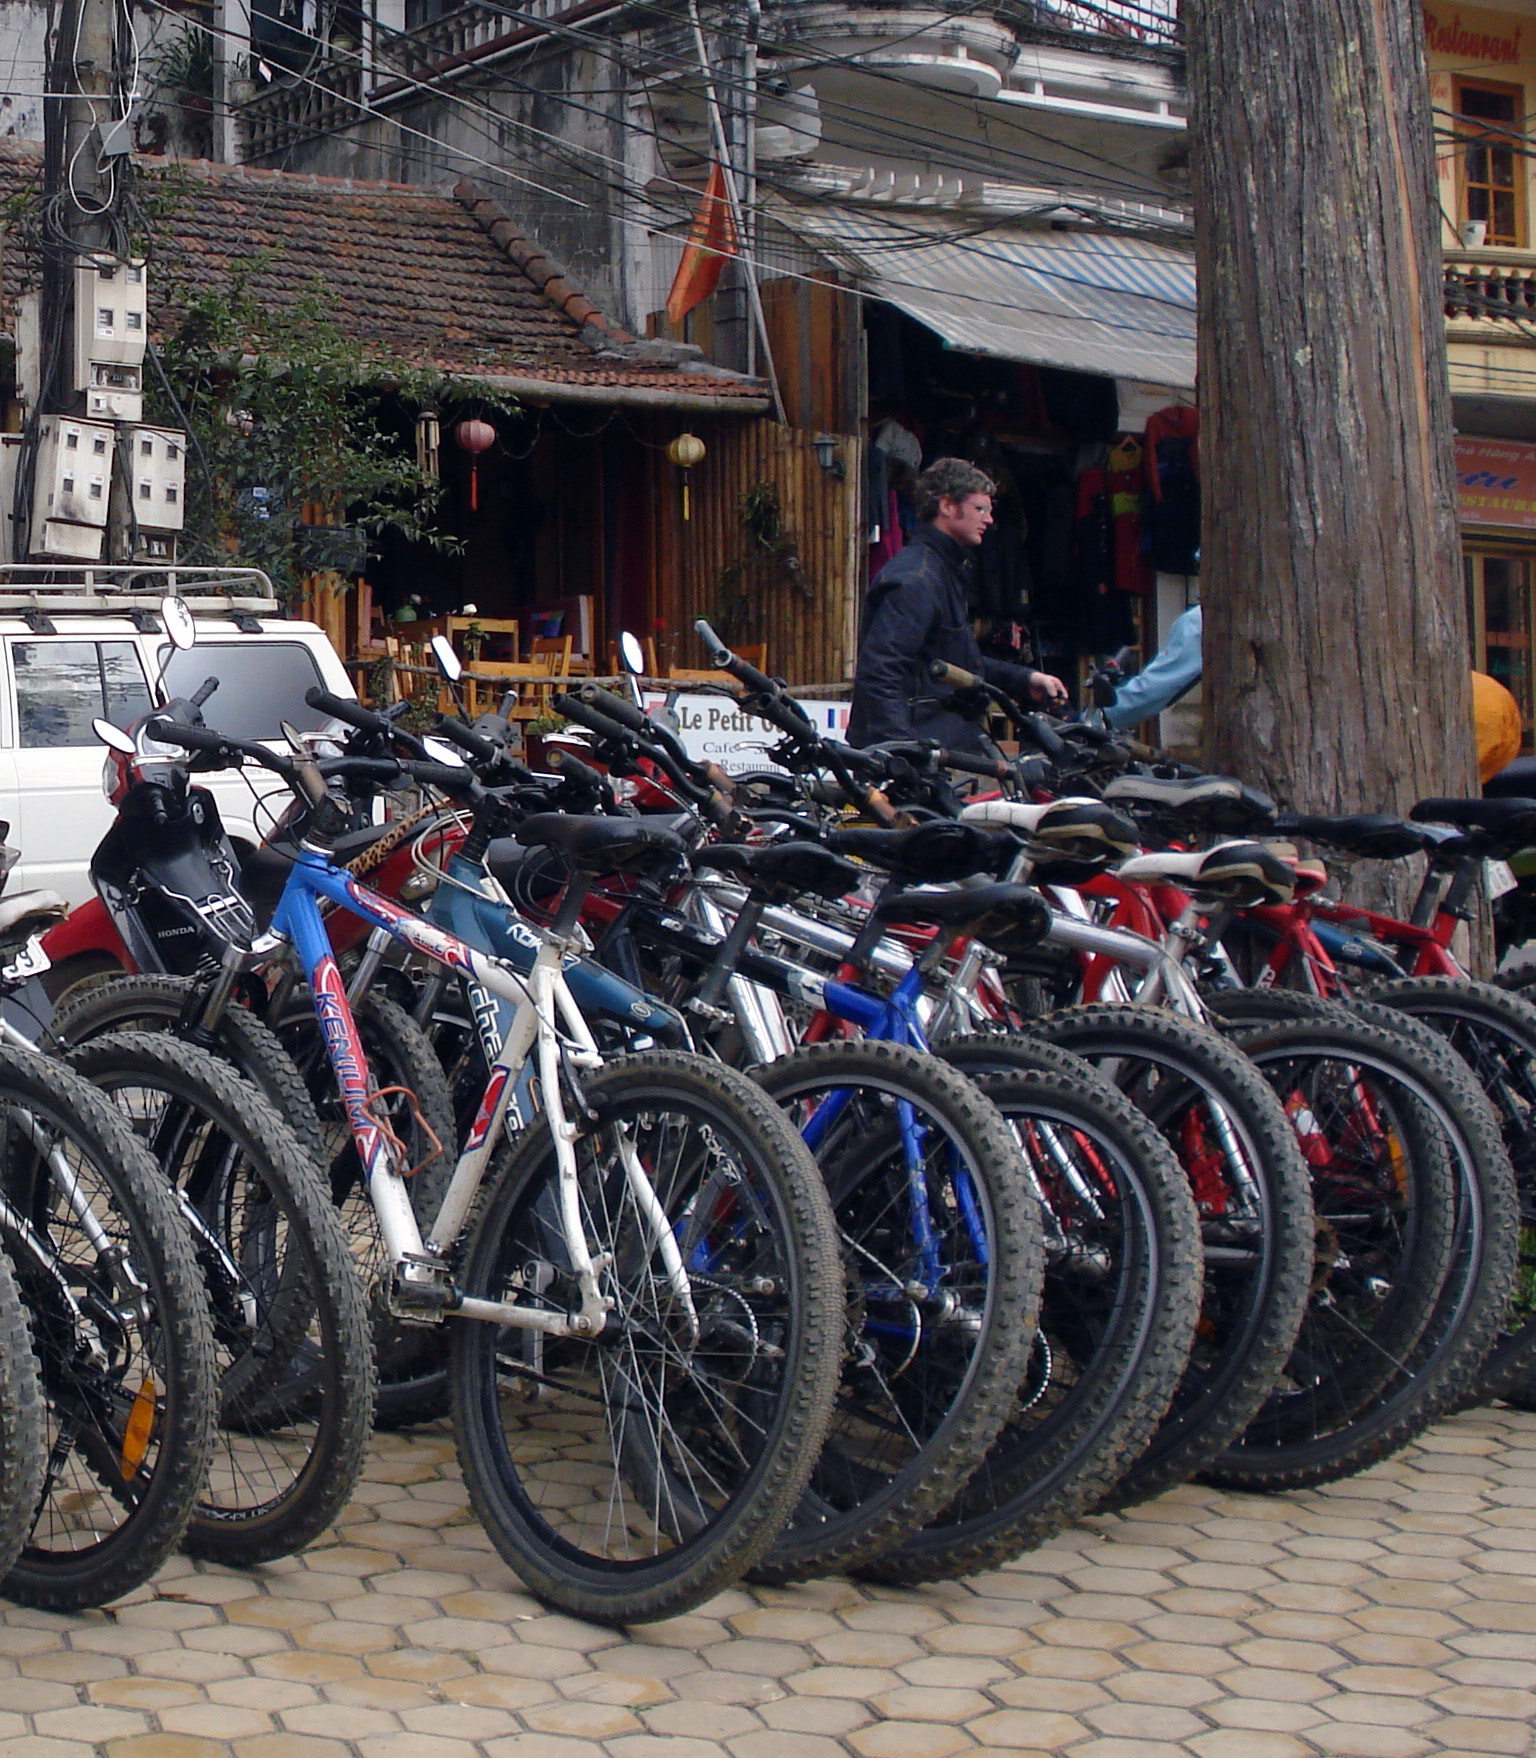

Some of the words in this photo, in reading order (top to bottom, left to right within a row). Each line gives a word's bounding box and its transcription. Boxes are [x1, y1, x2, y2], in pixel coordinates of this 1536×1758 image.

[681, 707, 703, 730] Le
[707, 707, 754, 733] Petit
[157, 925, 196, 939] HONDA
